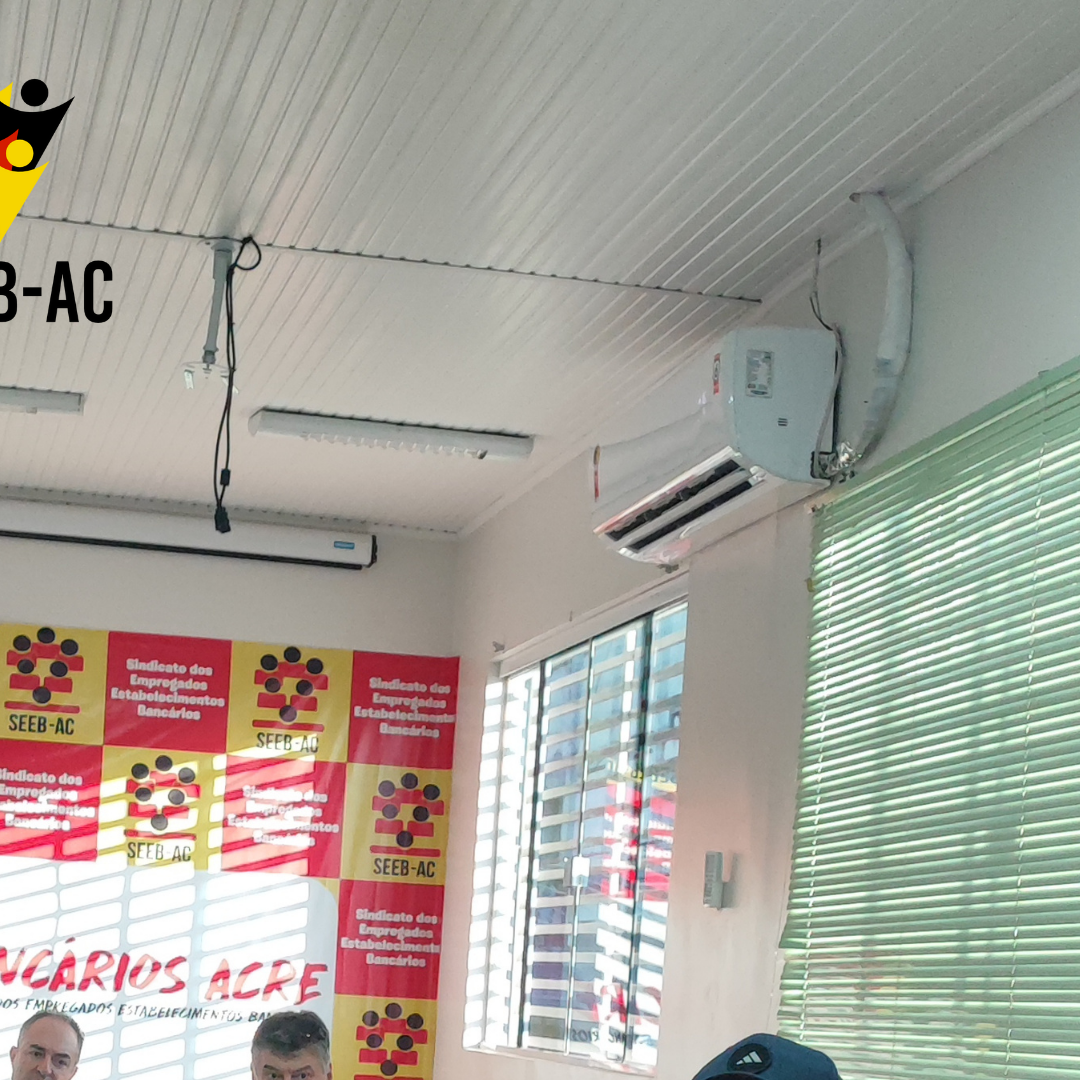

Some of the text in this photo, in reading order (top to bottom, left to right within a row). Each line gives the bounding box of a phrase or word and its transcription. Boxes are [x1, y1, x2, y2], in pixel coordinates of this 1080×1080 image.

[126, 658, 213, 676] Sindicato dos
[130, 674, 208, 692] Empregados
[369, 677, 451, 694] Sindicato dos
[111, 687, 225, 707] Estabelecimentos
[373, 692, 447, 710] Empregados
[137, 704, 201, 720] Bancários
[8, 714, 74, 736] SEEB-AC
[379, 722, 440, 738] Bancários
[256, 732, 319, 753] SEEB-AC
[59, 773, 83, 786] dos
[127, 841, 191, 862] SEEB-AC
[373, 858, 436, 879] SEEB-AC
[356, 908, 438, 924] Sindicato dos
[359, 923, 433, 940] Empregados
[366, 953, 426, 967] Bancários
[204, 958, 328, 1006] ACRE
